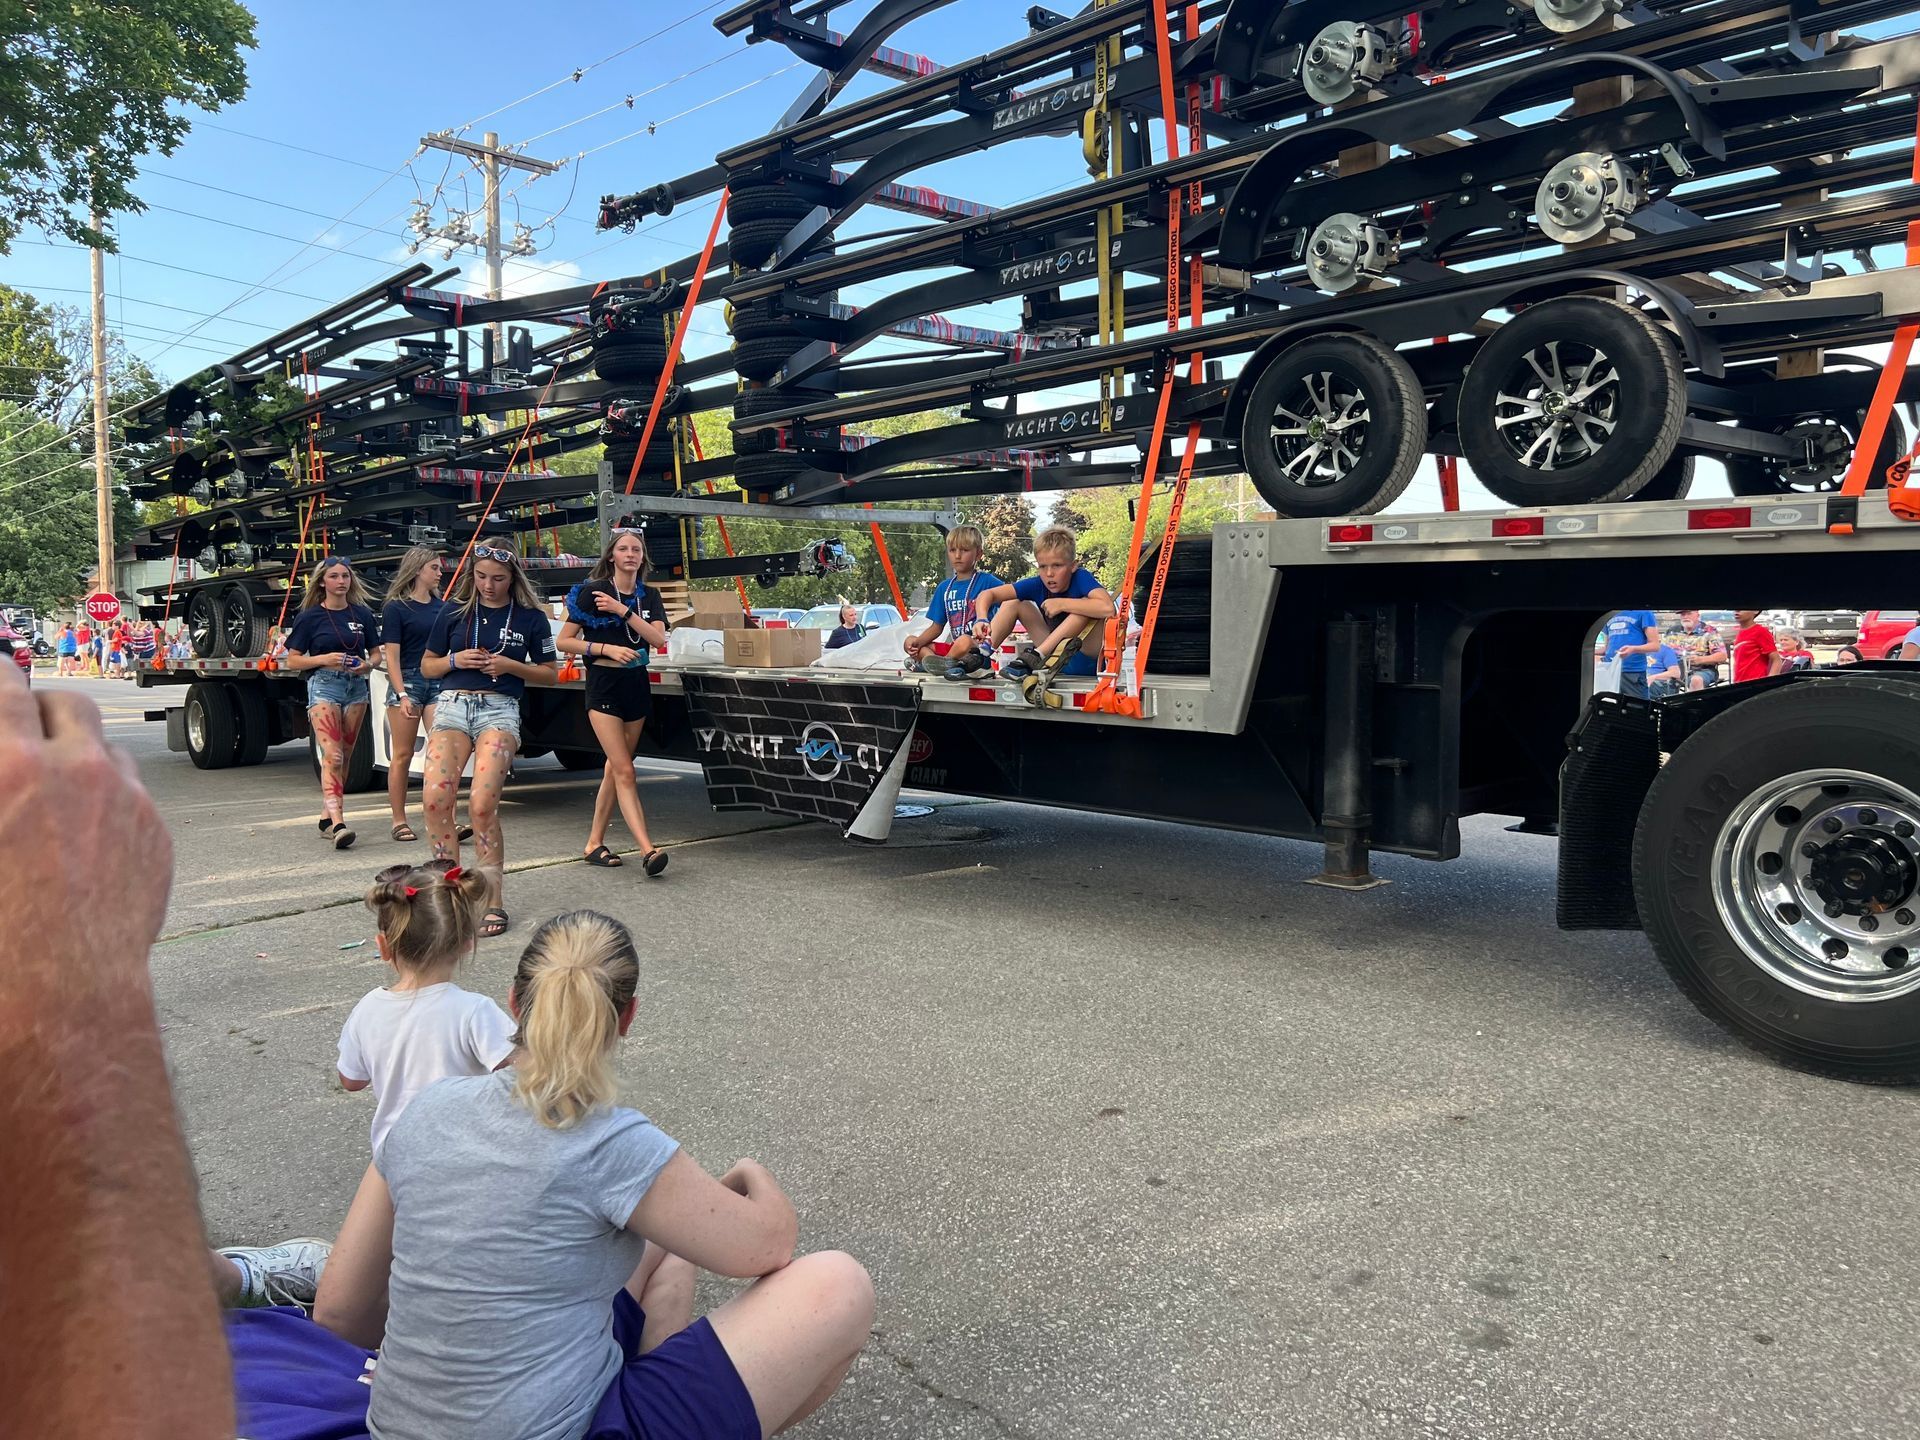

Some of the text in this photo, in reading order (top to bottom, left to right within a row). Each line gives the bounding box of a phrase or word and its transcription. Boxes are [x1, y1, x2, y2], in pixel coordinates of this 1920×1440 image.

[1097, 67, 1105, 94] CARG
[993, 74, 1117, 130] YACHT CLB
[1192, 183, 1200, 206] RGO
[1001, 240, 1122, 285] YACHT CLB
[1170, 227, 1178, 277] CONTROL
[1169, 278, 1177, 311] CARGO
[1169, 313, 1176, 329] US
[1006, 404, 1126, 439] YACHT CLB
[1168, 519, 1177, 532] US
[1160, 534, 1174, 568] CARGO
[1150, 568, 1165, 611] CONTROL
[88, 602, 118, 613] STOP
[699, 728, 882, 773] YACHT CL
[911, 739, 930, 753] SEY
